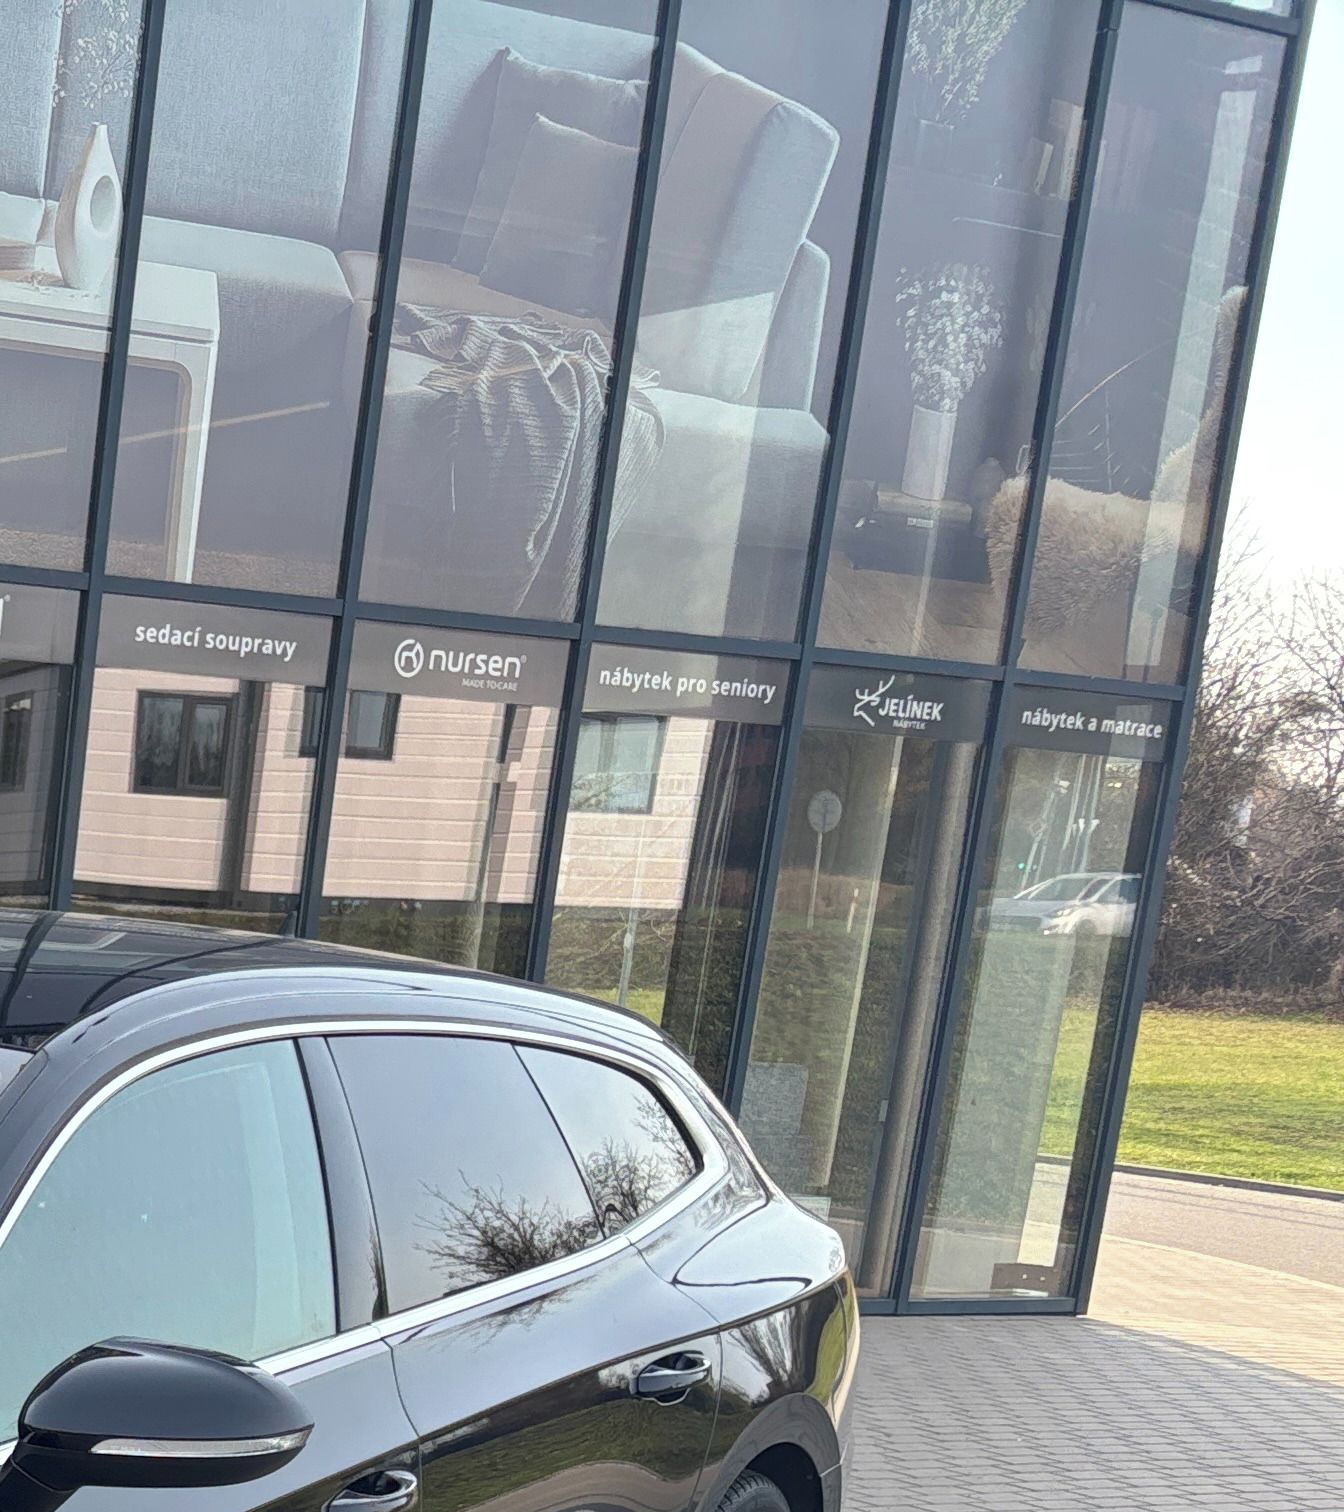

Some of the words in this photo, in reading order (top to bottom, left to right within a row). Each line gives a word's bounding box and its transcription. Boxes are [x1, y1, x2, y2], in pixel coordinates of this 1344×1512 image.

[134, 623, 202, 647] sedací
[204, 632, 297, 662] soupravy
[429, 649, 521, 678] nursen
[599, 666, 672, 693] nábytek
[676, 676, 707, 697] pro
[711, 678, 776, 704] seniory
[878, 694, 944, 721] JELÍNEK
[1021, 708, 1085, 732] nábytek
[1088, 717, 1097, 731] a
[1100, 719, 1163, 738] matrace
